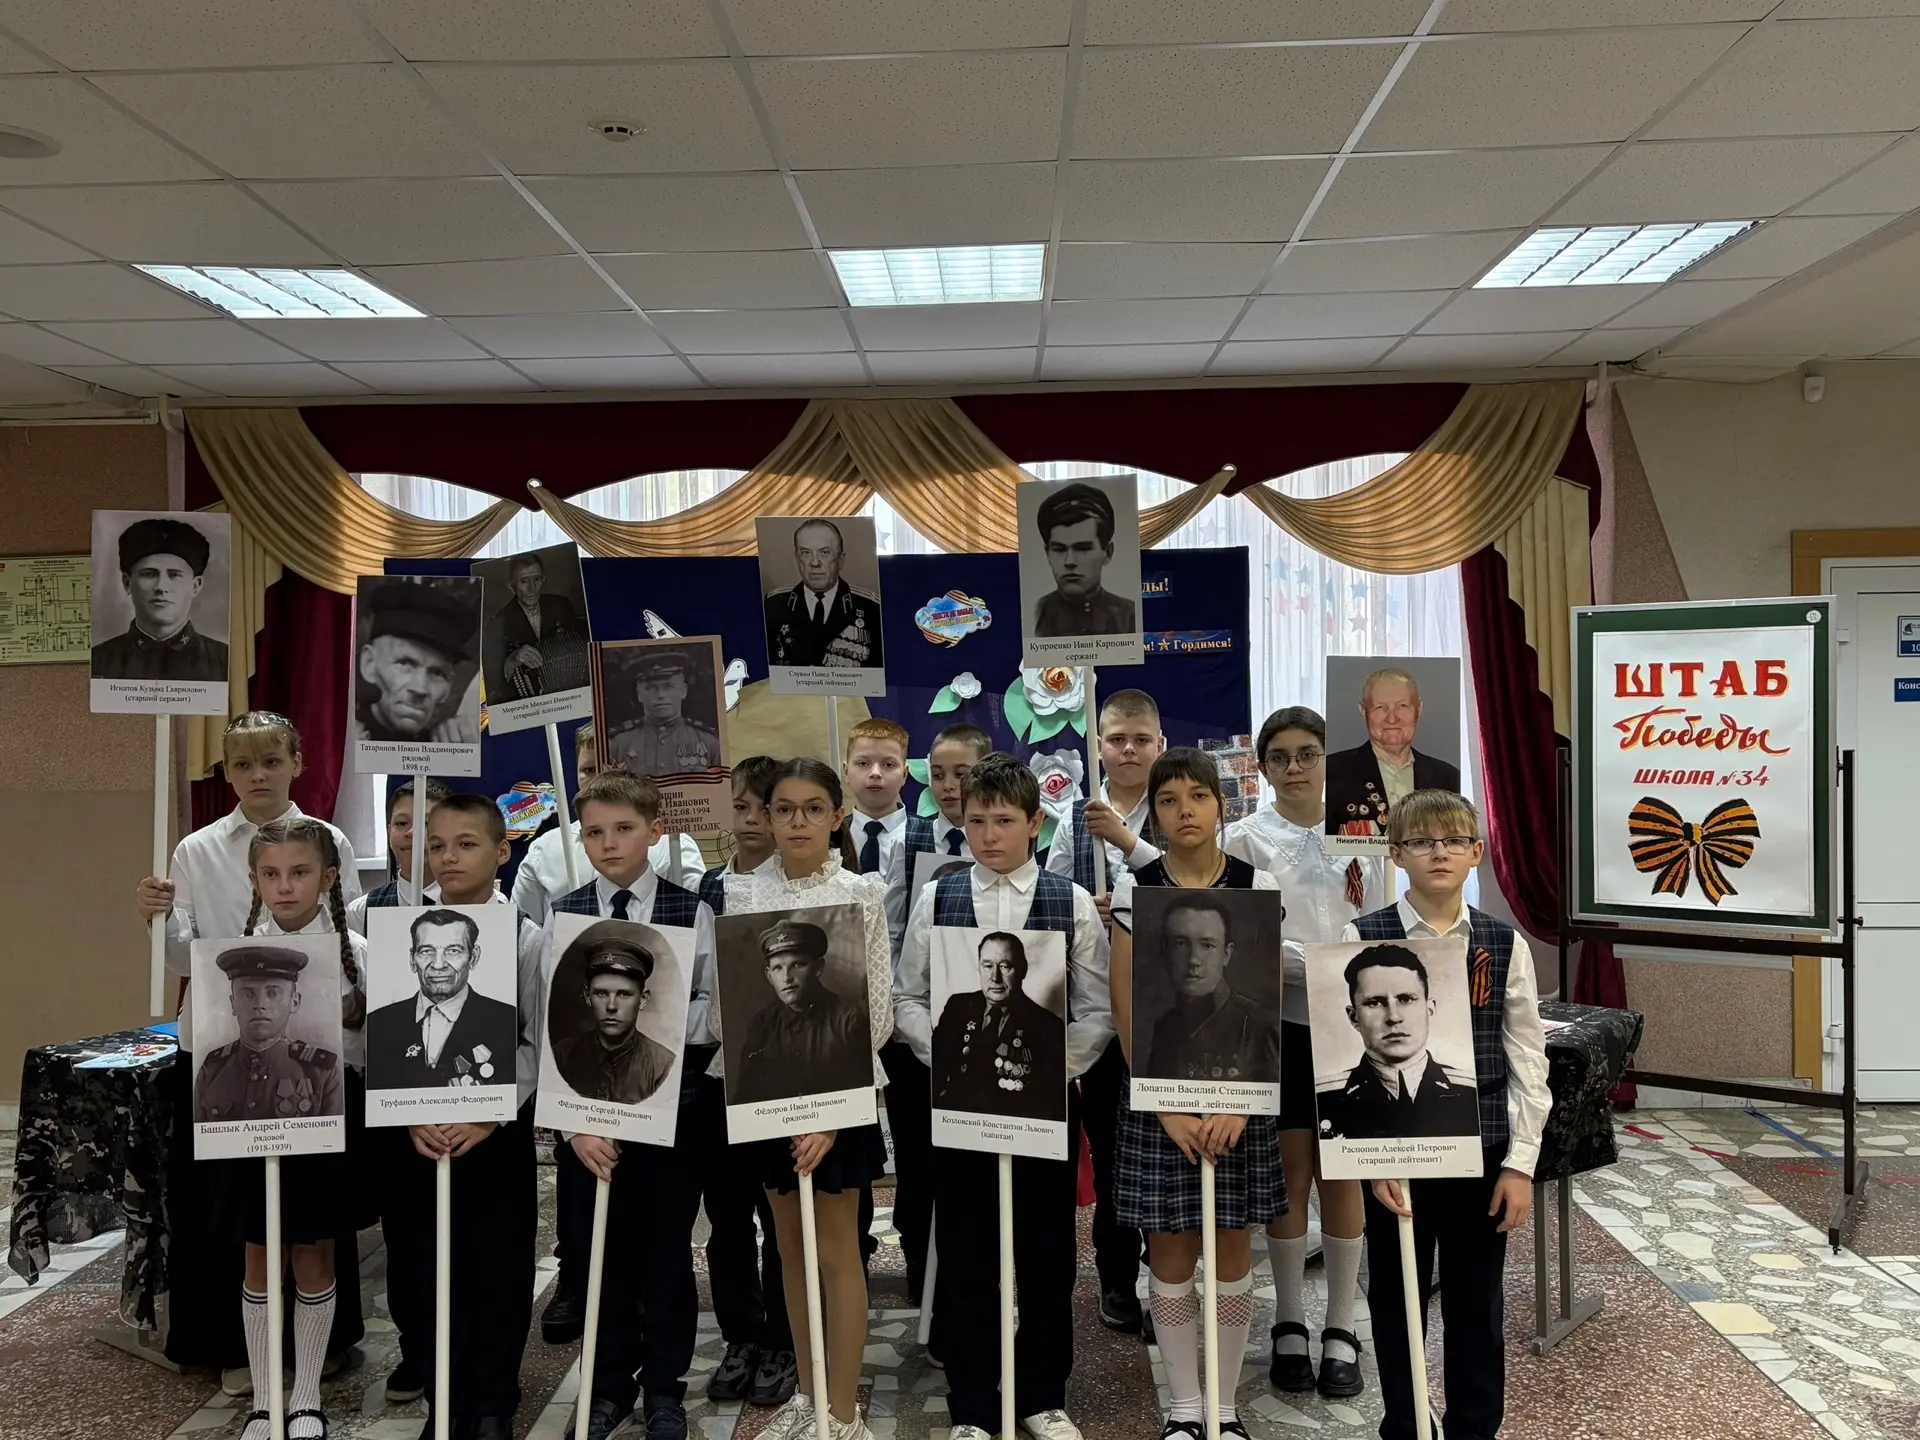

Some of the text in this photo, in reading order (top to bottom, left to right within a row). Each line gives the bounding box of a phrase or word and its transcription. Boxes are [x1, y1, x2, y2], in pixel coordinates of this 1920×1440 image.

[1029, 641, 1072, 652] Куприенко
[1073, 640, 1094, 650] Иван
[1095, 639, 1135, 650] Карпович
[1173, 637, 1232, 652] Гордимся!
[1065, 653, 1098, 662] сержант
[795, 679, 857, 688] (старший лейтенант)
[1614, 659, 1789, 698] ШТАБ
[109, 684, 207, 694] Игнатов Кузьма Гаврилович
[124, 694, 191, 704] (старший сержант)
[513, 703, 573, 721] (старший лейтенант)
[1612, 704, 1792, 756] Победы
[360, 743, 474, 756] Татаринов Никон Владимирович
[402, 754, 431, 763] рядовой
[402, 763, 419, 771] 1898
[1632, 767, 1716, 785] ШКОЛА
[666, 798, 710, 809] Иванович
[671, 816, 704, 825] сержант
[693, 822, 721, 832] ПОЛК
[1336, 837, 1367, 845] Никитин
[1137, 1083, 1273, 1097] Лопатин Василий Степанович
[379, 1098, 418, 1108] Труфанов
[418, 1097, 460, 1106] Александр
[754, 1097, 848, 1116] Фёдоров Иван Иванович
[1158, 1099, 1252, 1110] младший лейтенант
[558, 1100, 652, 1121] Фёдоров Сергей Иванович
[585, 1115, 621, 1128] (рядовой)
[782, 1111, 820, 1125] (рядовой)
[200, 1119, 338, 1134] Башлык Андрей Семенович
[941, 1115, 1055, 1135] Козловский Константин Львович
[253, 1132, 286, 1144] рядовой
[980, 1129, 1015, 1142] (капитан)
[246, 1142, 292, 1154] (1918-1939)
[1341, 1143, 1458, 1156] Распопов Алексей Петрович
[1357, 1154, 1443, 1167] (старший лейтенант)
